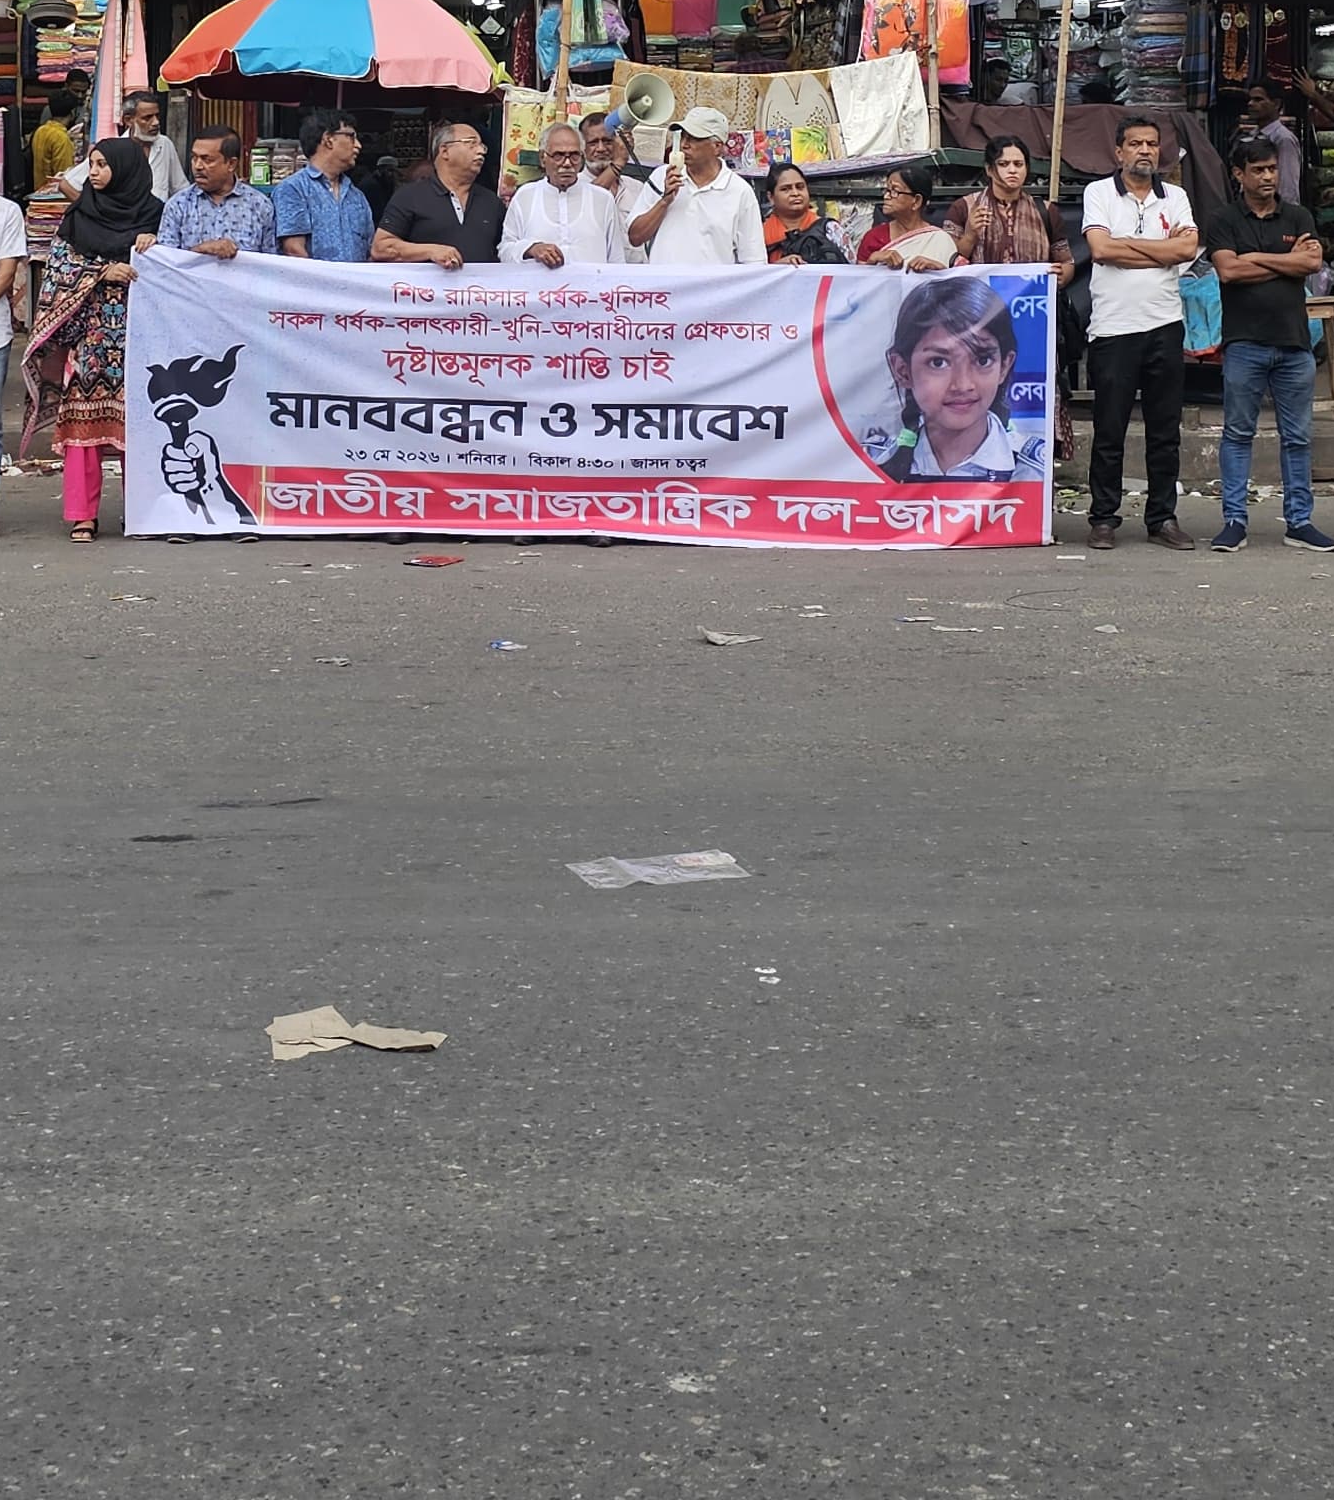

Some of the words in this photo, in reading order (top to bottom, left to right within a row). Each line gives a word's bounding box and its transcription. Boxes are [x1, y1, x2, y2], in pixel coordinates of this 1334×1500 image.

[392, 282, 434, 305] শিশু
[446, 283, 528, 309] রামিসার
[540, 282, 670, 313] ধর্ষক-খুনিসহ
[269, 310, 324, 332] সকল
[684, 318, 771, 343] গ্রেফতার
[781, 324, 798, 340] ও
[383, 347, 535, 386] দৃষ্টান্তমূলক
[545, 346, 611, 380] শাস্তি
[622, 347, 676, 383] চাই
[267, 391, 528, 443] মানববন্ধন
[542, 403, 578, 438] ও
[592, 402, 789, 442] সমাবেশ
[344, 449, 367, 461] ২৩
[373, 449, 390, 463] মে
[396, 450, 440, 464] ২০২৬
[457, 450, 507, 466] শনিবার
[529, 452, 571, 469] বিকাল
[631, 457, 669, 470] জাসদ
[675, 458, 709, 472] চত্বর
[262, 470, 436, 519] জাতীয়
[448, 478, 753, 530] সমাজতান্ত্রিক
[768, 494, 1025, 535] দল-জাসদ
